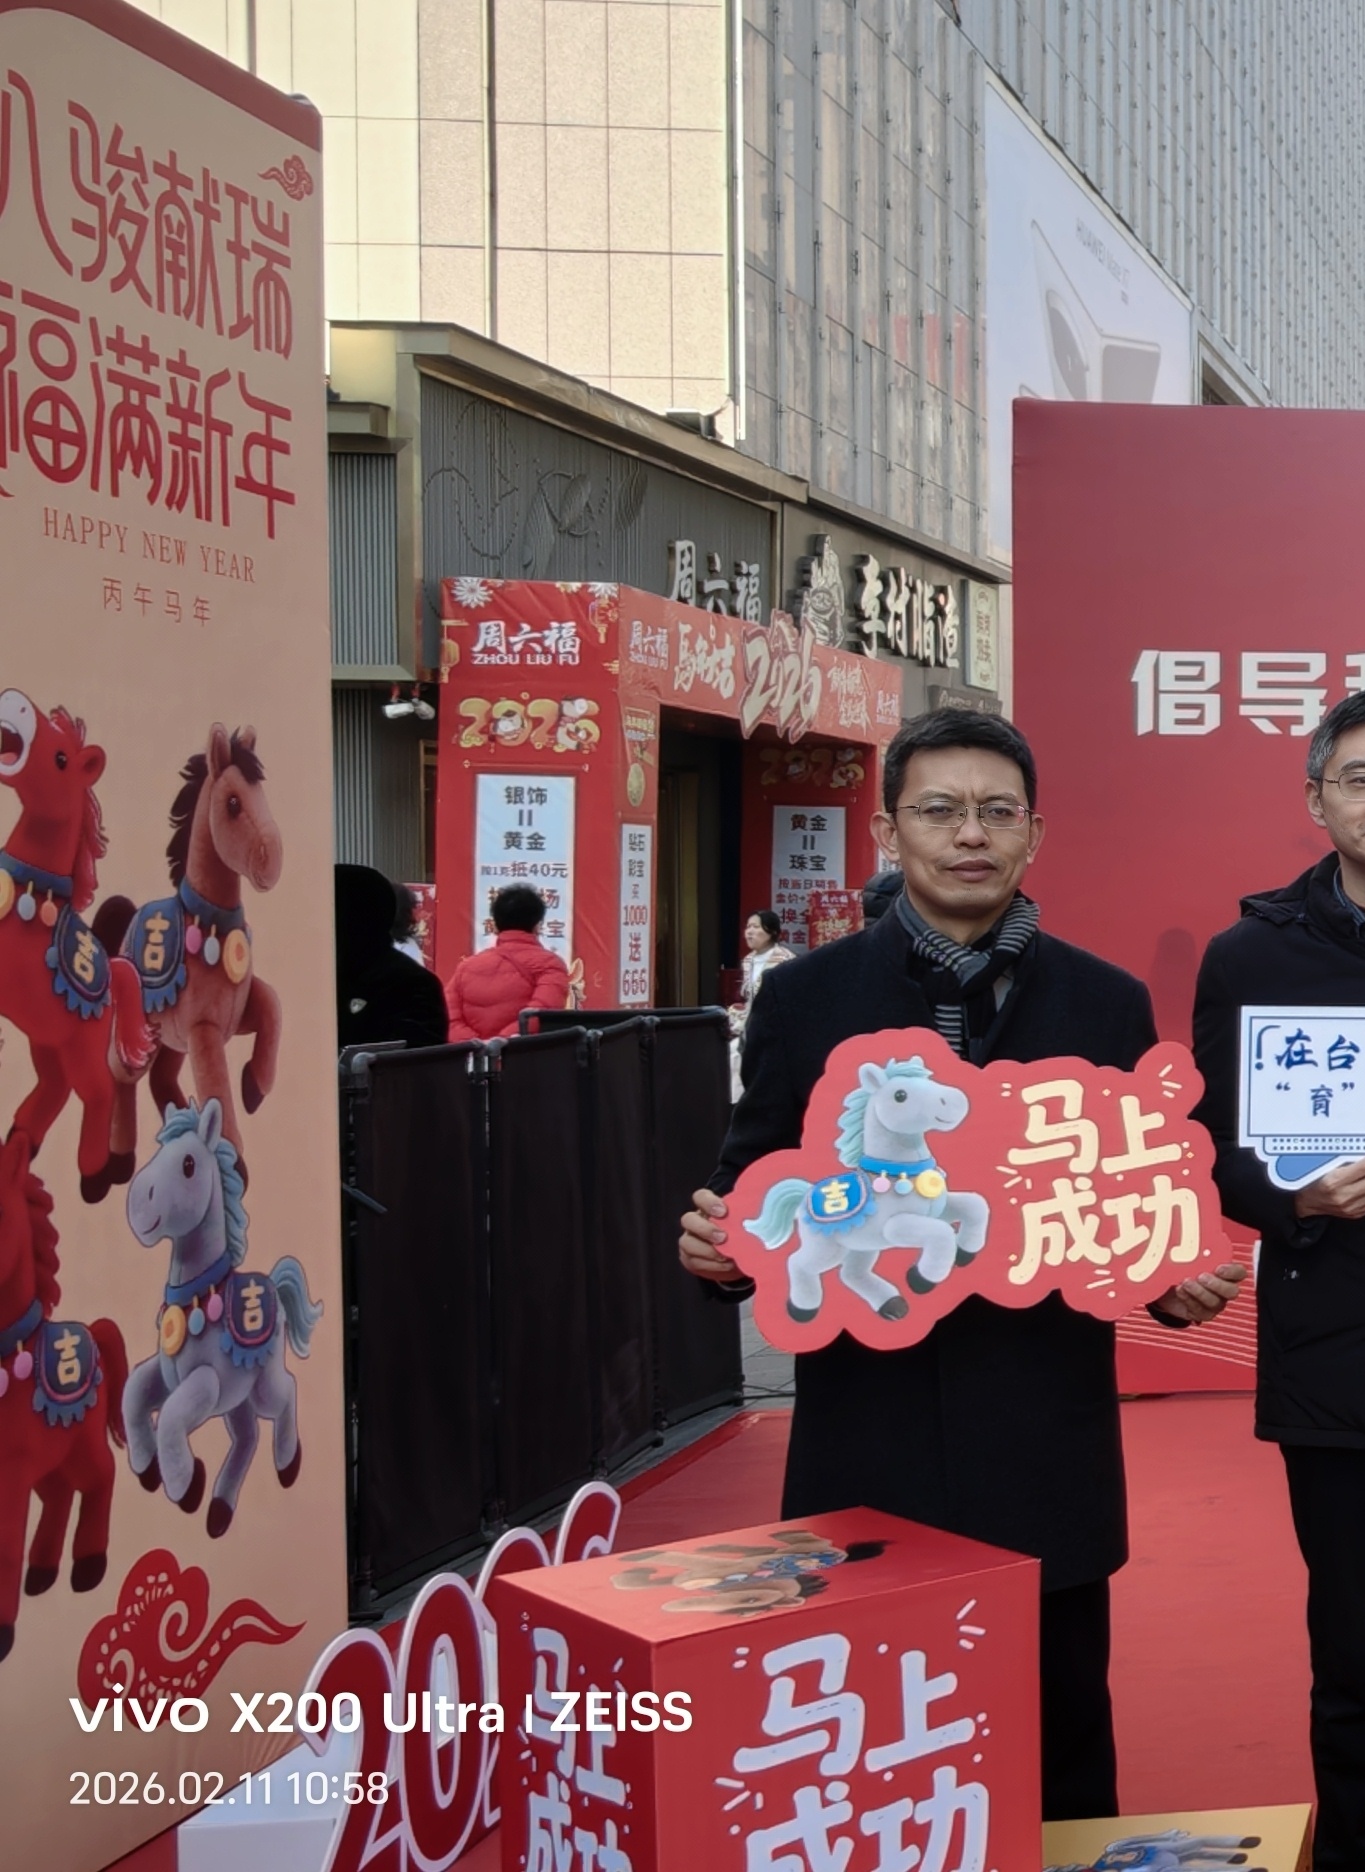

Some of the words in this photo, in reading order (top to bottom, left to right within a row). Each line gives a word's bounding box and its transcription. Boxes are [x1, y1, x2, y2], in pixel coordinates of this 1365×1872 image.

[0, 69, 293, 360] 八骏献瑞
[0, 278, 296, 541] 福满新年
[43, 506, 129, 554] HAPPY
[142, 530, 187, 568] NEW
[200, 545, 256, 584] YEAR
[103, 576, 212, 627] 丙午马年
[670, 539, 762, 624] 周六福
[471, 620, 581, 655] 周六福
[471, 653, 520, 666] ZHOU
[526, 653, 552, 666] LIU
[558, 653, 580, 667] FU
[504, 786, 548, 806] 银饰
[790, 813, 828, 832] 黄金
[503, 831, 546, 852] 黄金
[789, 854, 828, 872] 珠宝
[1007, 1079, 1183, 1177] 马上
[820, 1180, 858, 1213] 吉
[1008, 1175, 1201, 1286] 成功
[241, 1278, 265, 1332] 吉
[53, 1328, 81, 1386] 吉
[733, 1633, 977, 1778] 马上
